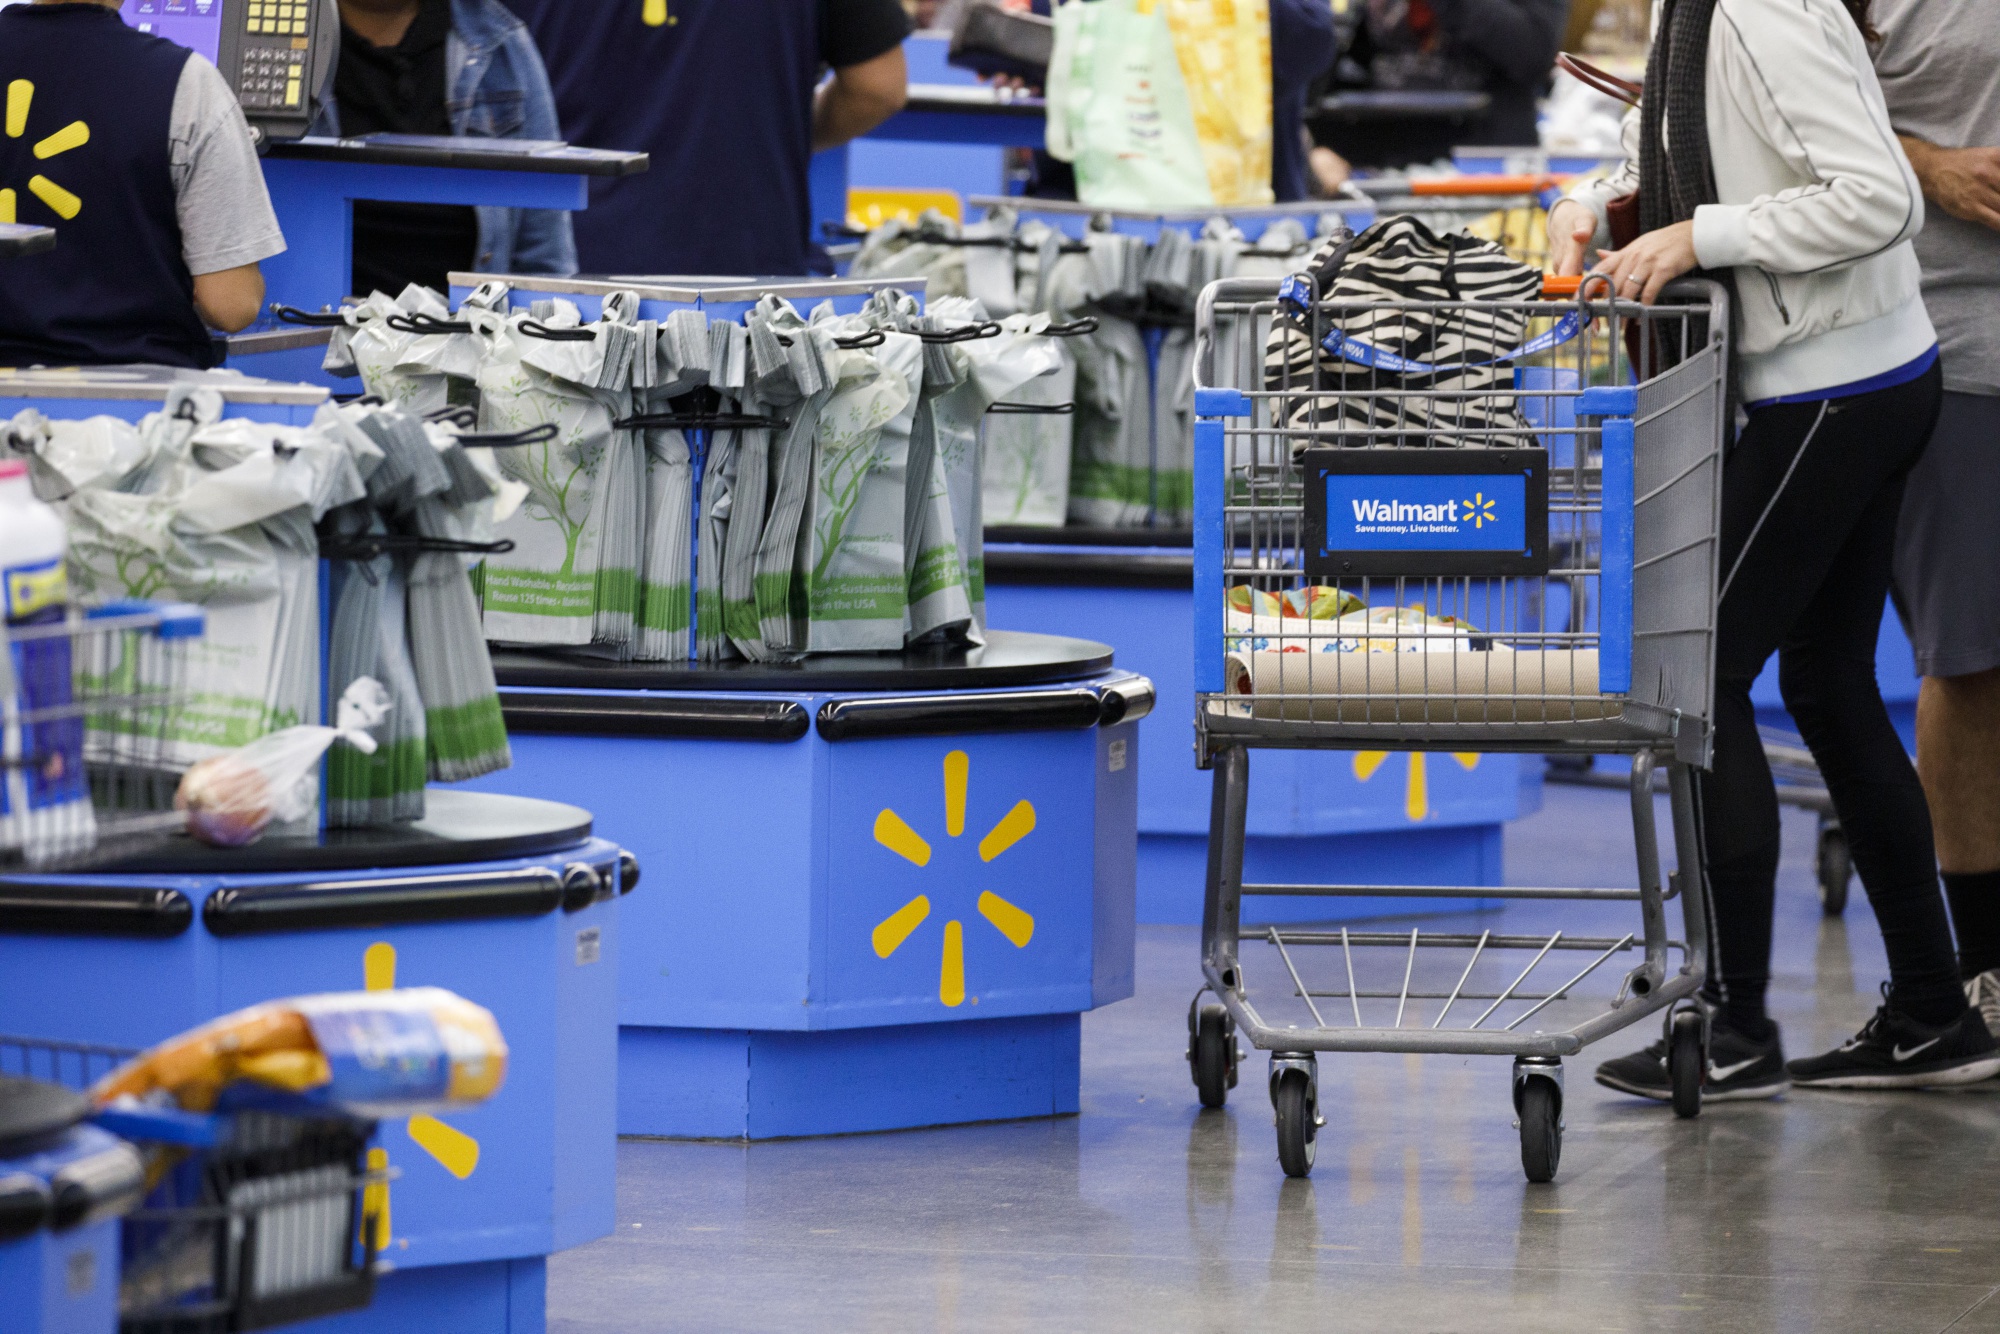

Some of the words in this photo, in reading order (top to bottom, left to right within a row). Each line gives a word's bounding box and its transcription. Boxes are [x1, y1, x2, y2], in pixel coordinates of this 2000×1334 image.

[1352, 499, 1458, 522] Walmart
[1355, 524, 1376, 533] Save
[1377, 524, 1409, 534] money.
[1410, 524, 1429, 533] Live
[1429, 524, 1460, 533] better.
[841, 583, 904, 595] Sustainable
[520, 593, 535, 604] 125
[853, 598, 877, 610] USA
